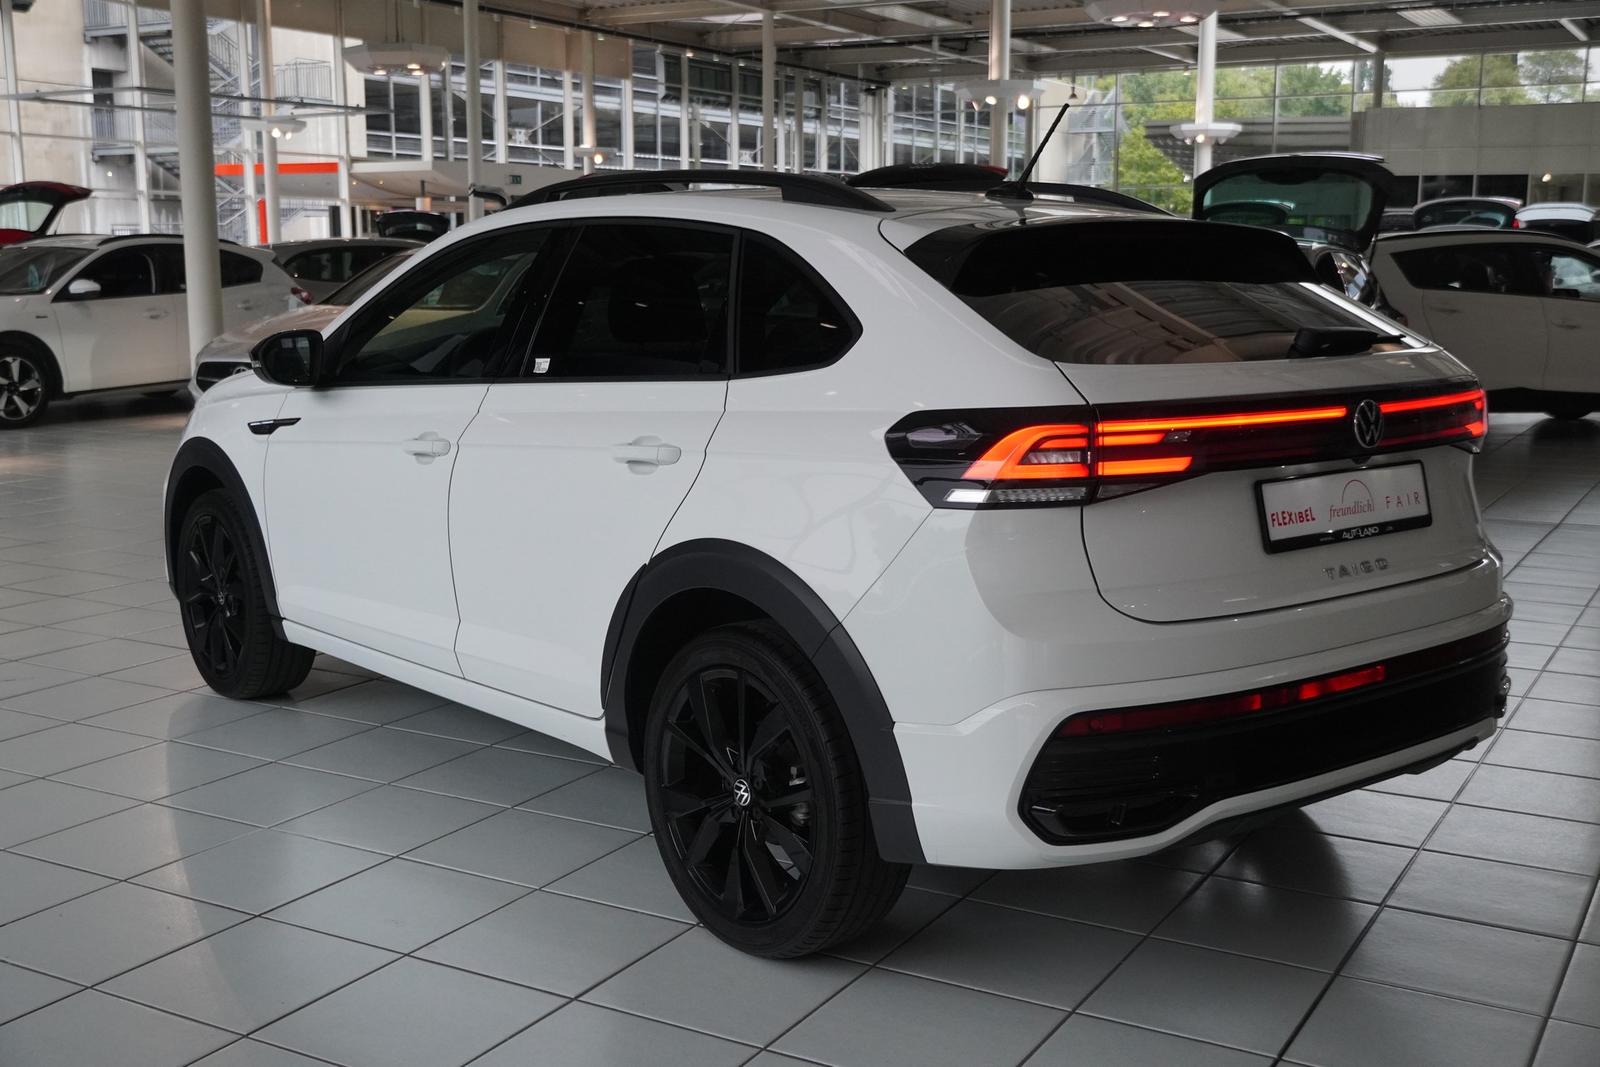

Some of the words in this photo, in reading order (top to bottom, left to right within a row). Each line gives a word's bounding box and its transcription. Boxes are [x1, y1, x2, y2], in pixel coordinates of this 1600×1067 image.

[1355, 400, 1384, 447] VW
[1271, 507, 1316, 527] FLEXIBEL
[1328, 499, 1374, 522] freundlich
[1385, 491, 1421, 509] FAIR
